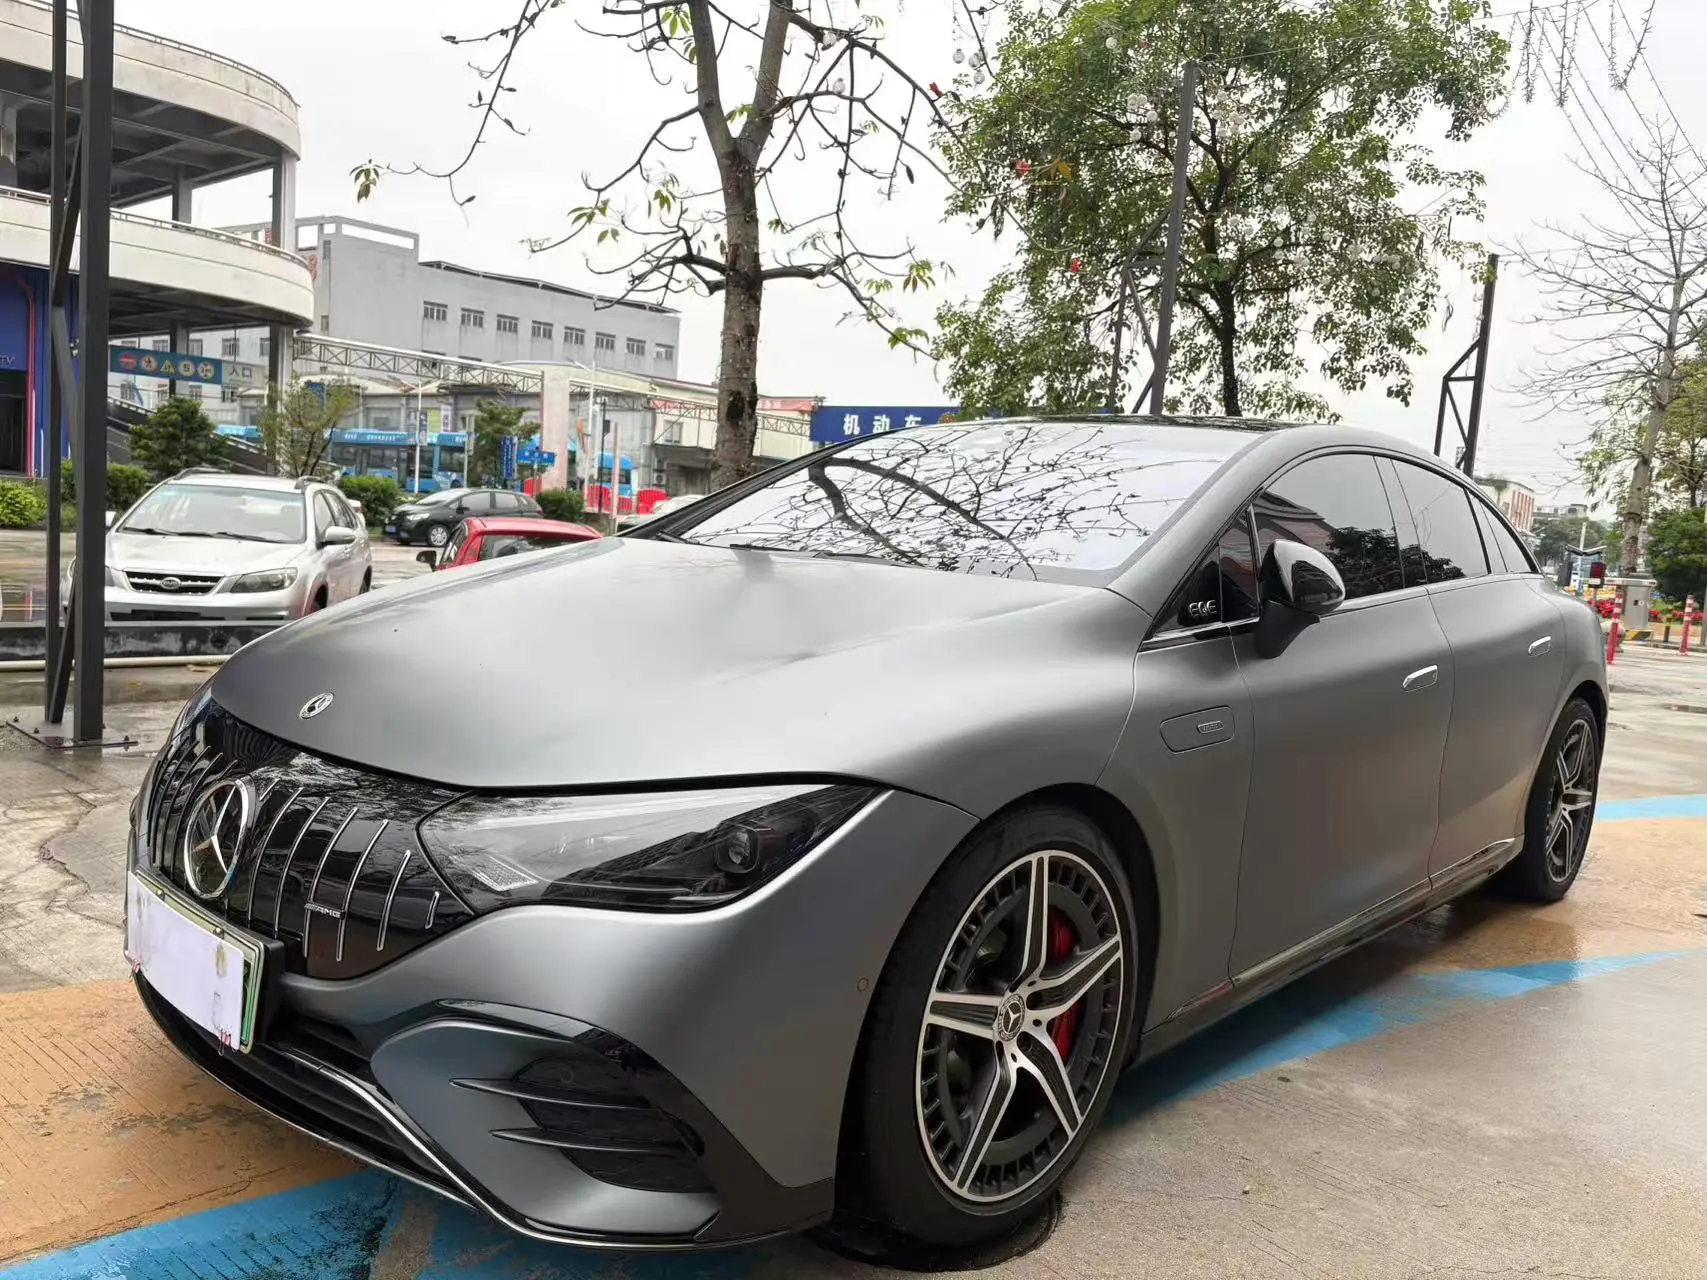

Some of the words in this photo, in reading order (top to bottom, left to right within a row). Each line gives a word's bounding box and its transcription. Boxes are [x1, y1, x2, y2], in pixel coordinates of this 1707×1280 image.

[229, 365, 252, 378] 入口
[843, 413, 922, 436] 机动车
[1189, 599, 1217, 617] EQE
[315, 905, 341, 919] AMG
